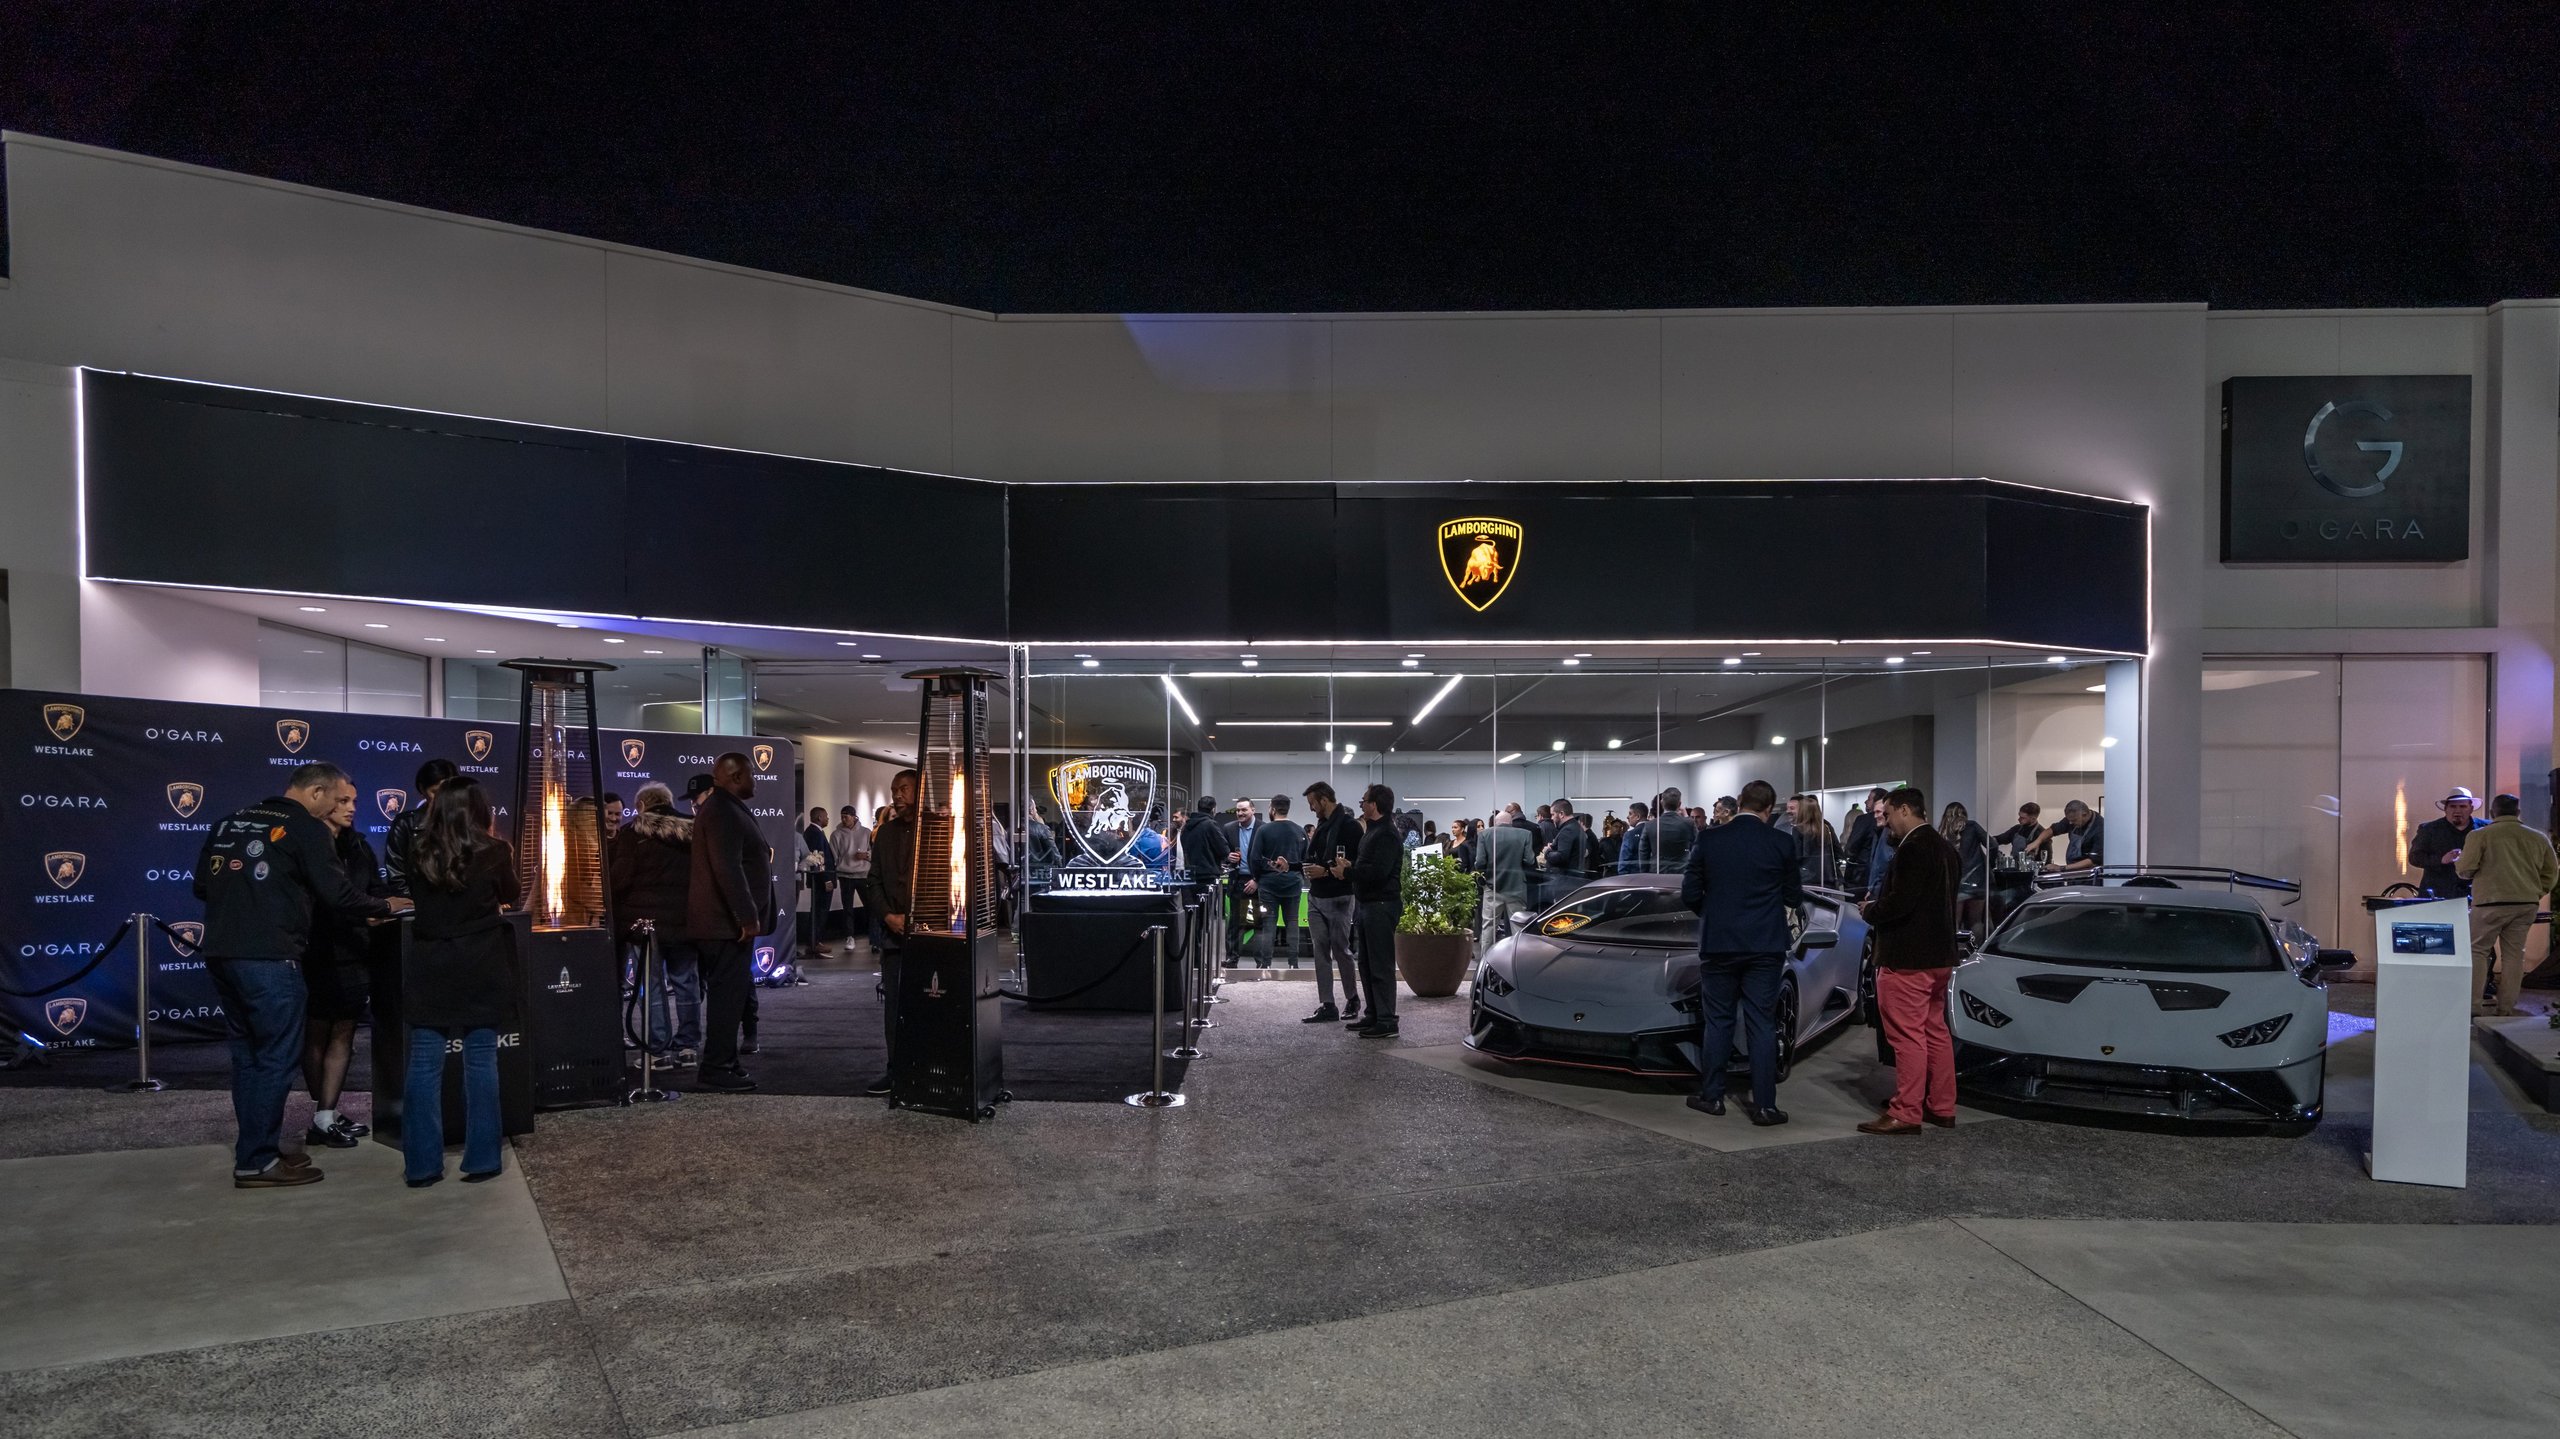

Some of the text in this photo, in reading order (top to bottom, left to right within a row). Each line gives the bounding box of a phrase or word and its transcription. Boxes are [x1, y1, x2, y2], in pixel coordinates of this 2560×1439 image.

[1444, 521, 1517, 539] LAMBORGHINI
[2279, 518, 2425, 541] O'GARA
[146, 728, 224, 743] O'GARA
[34, 745, 94, 757] WESTLAKE
[358, 740, 423, 753] O'GARA
[678, 755, 714, 765] O'GAR
[459, 765, 499, 774] WESTLAKE
[616, 771, 650, 779] WESTLAKE
[1068, 764, 1149, 784] LAMBORGHINI
[21, 794, 108, 809] O'GARA
[159, 823, 212, 831] WESTLAKE
[146, 869, 194, 881] O'GA
[1058, 873, 1157, 889] WESTLAKE
[35, 894, 95, 903] WESTLAKE
[159, 961, 207, 971] WESTLAK
[46, 1038, 96, 1049] ESTLAKE
